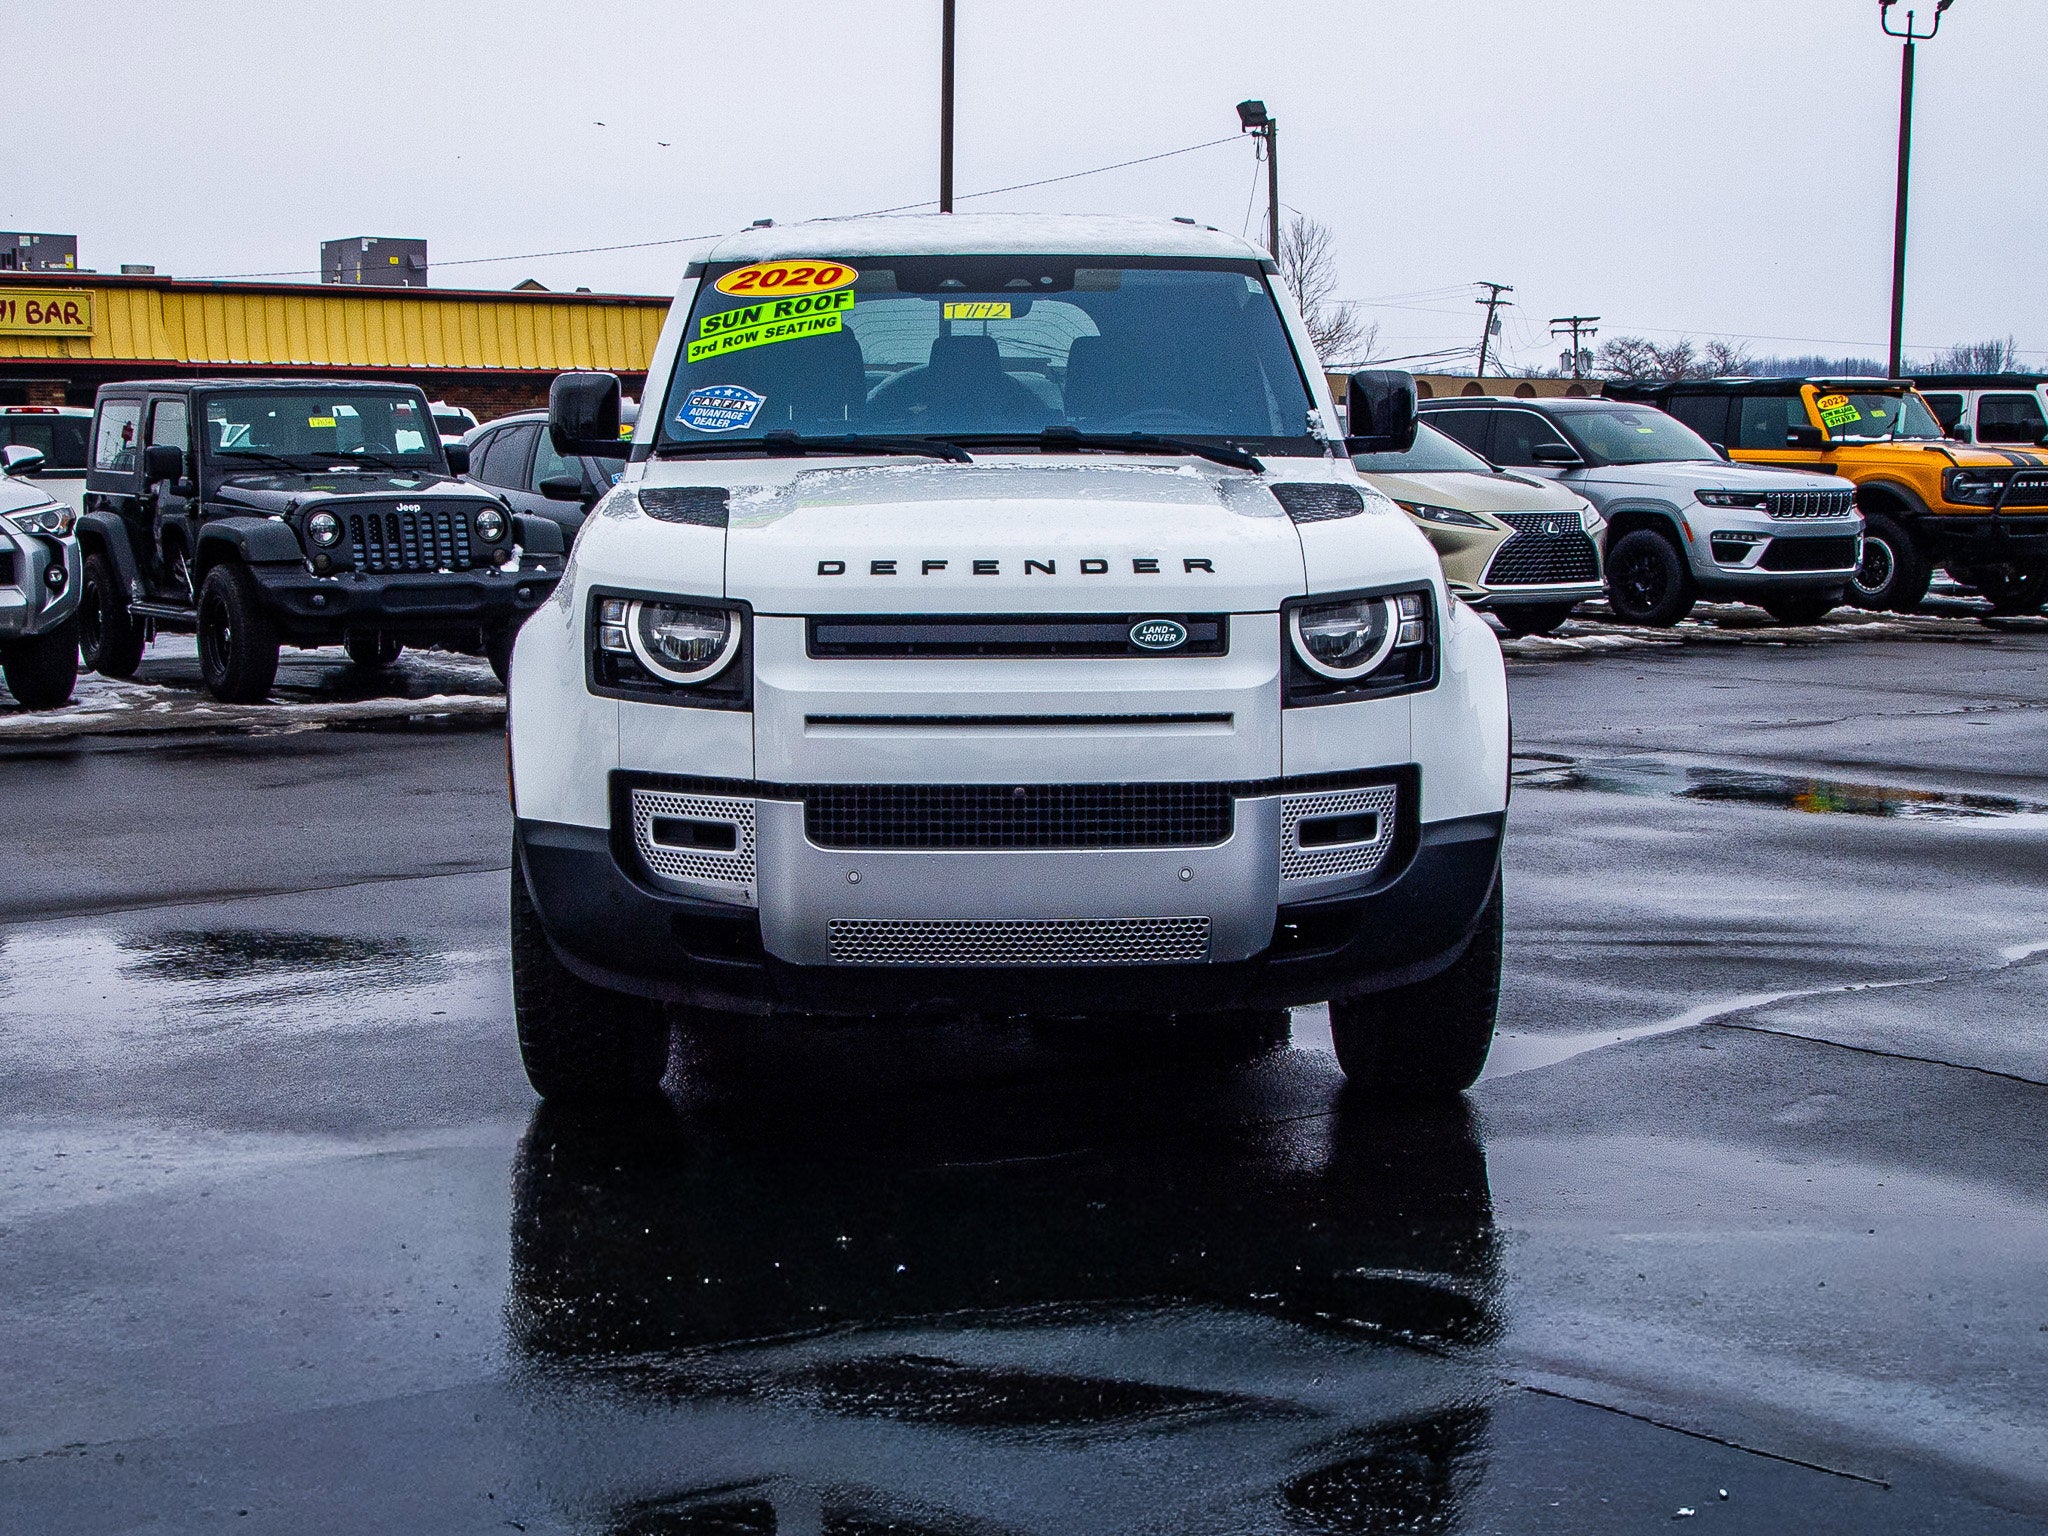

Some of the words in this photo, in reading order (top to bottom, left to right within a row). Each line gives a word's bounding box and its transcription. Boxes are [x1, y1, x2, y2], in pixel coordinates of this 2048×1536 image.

[728, 266, 844, 292] 2020
[25, 300, 85, 325] BAR
[703, 306, 763, 334] SUN
[774, 291, 850, 319] ROOF
[945, 303, 1007, 319] T7142
[691, 340, 718, 357] 3rd
[722, 331, 759, 349] ROW
[764, 316, 837, 339] SEATING
[691, 397, 754, 411] CARFAX
[1821, 395, 1846, 408] 2022
[689, 407, 745, 420] ADVANTAGE
[1829, 414, 1856, 425] SHARP
[693, 416, 731, 428] DEALER
[396, 502, 421, 513] Jeep
[817, 558, 1216, 576] DEFENDER
